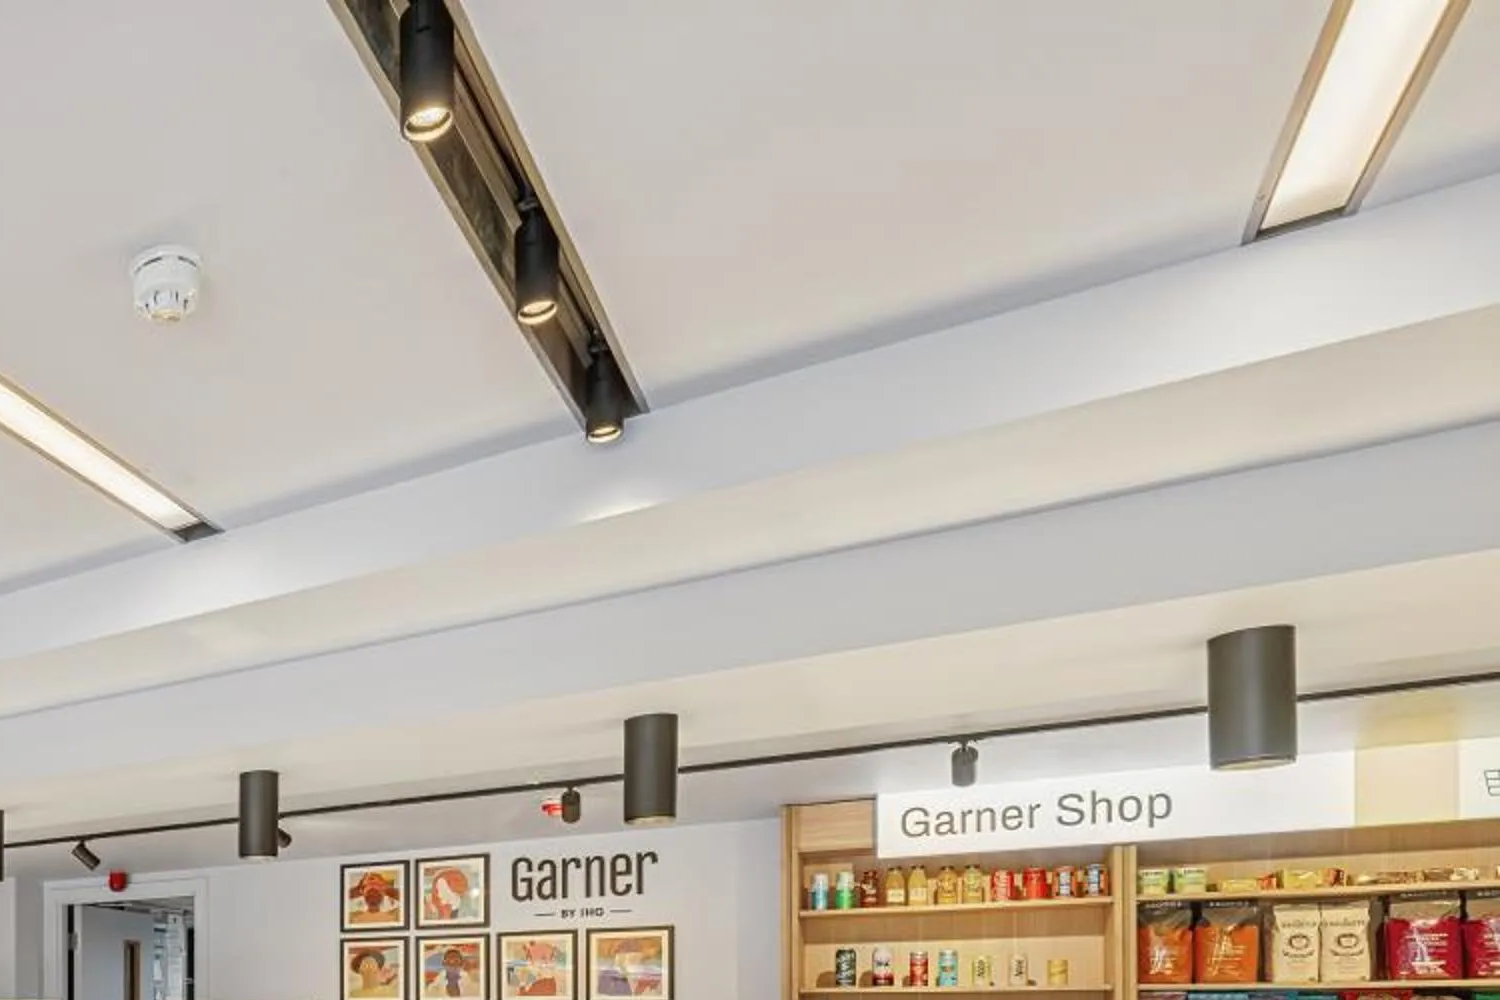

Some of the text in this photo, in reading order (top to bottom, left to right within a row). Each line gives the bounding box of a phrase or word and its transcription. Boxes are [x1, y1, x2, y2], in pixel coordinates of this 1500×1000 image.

[901, 790, 1172, 838] Garner Shop
[511, 850, 659, 902] Garner
[561, 909, 576, 919] BY
